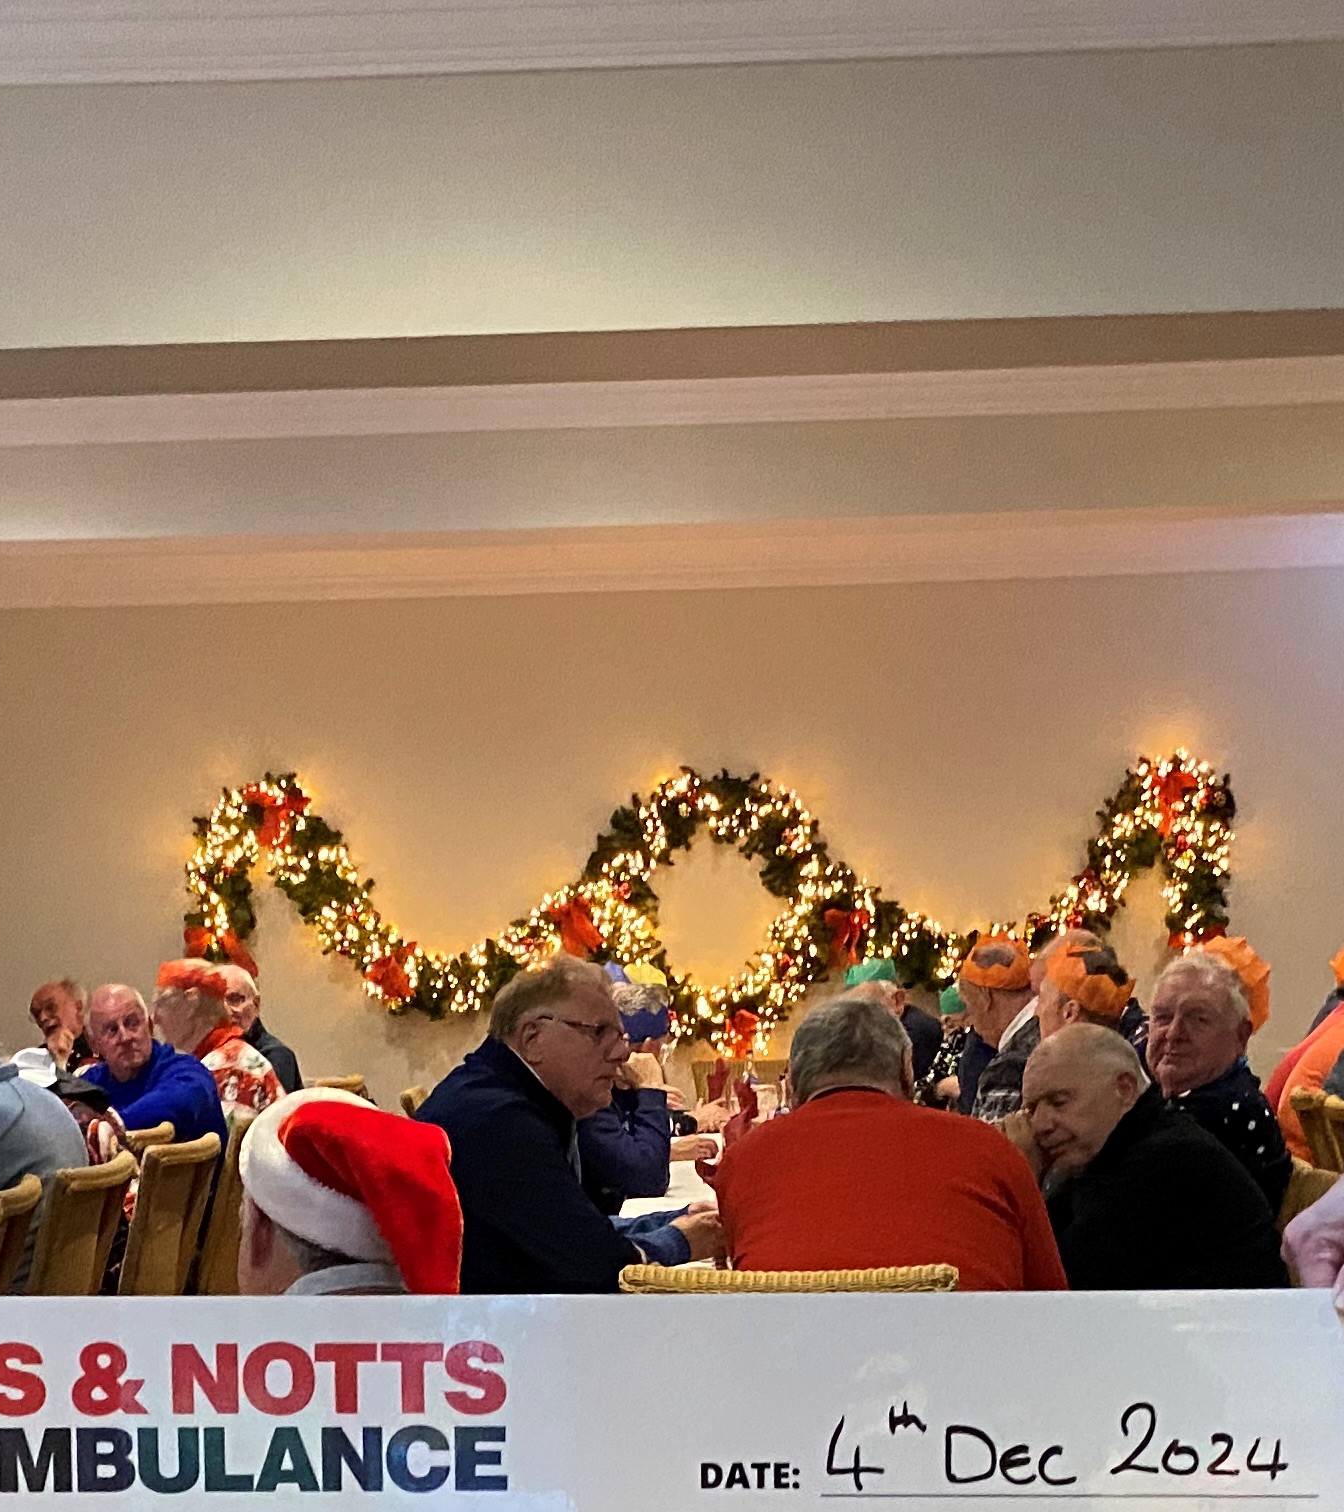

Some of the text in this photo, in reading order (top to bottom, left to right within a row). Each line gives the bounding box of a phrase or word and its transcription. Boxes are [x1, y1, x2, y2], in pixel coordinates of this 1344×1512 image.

[71, 1341, 149, 1417] &
[170, 1340, 508, 1417] NOTTS
[700, 1462, 801, 1490] DATE:
[944, 1424, 1078, 1486] Dec
[1109, 1401, 1289, 1481] 2024
